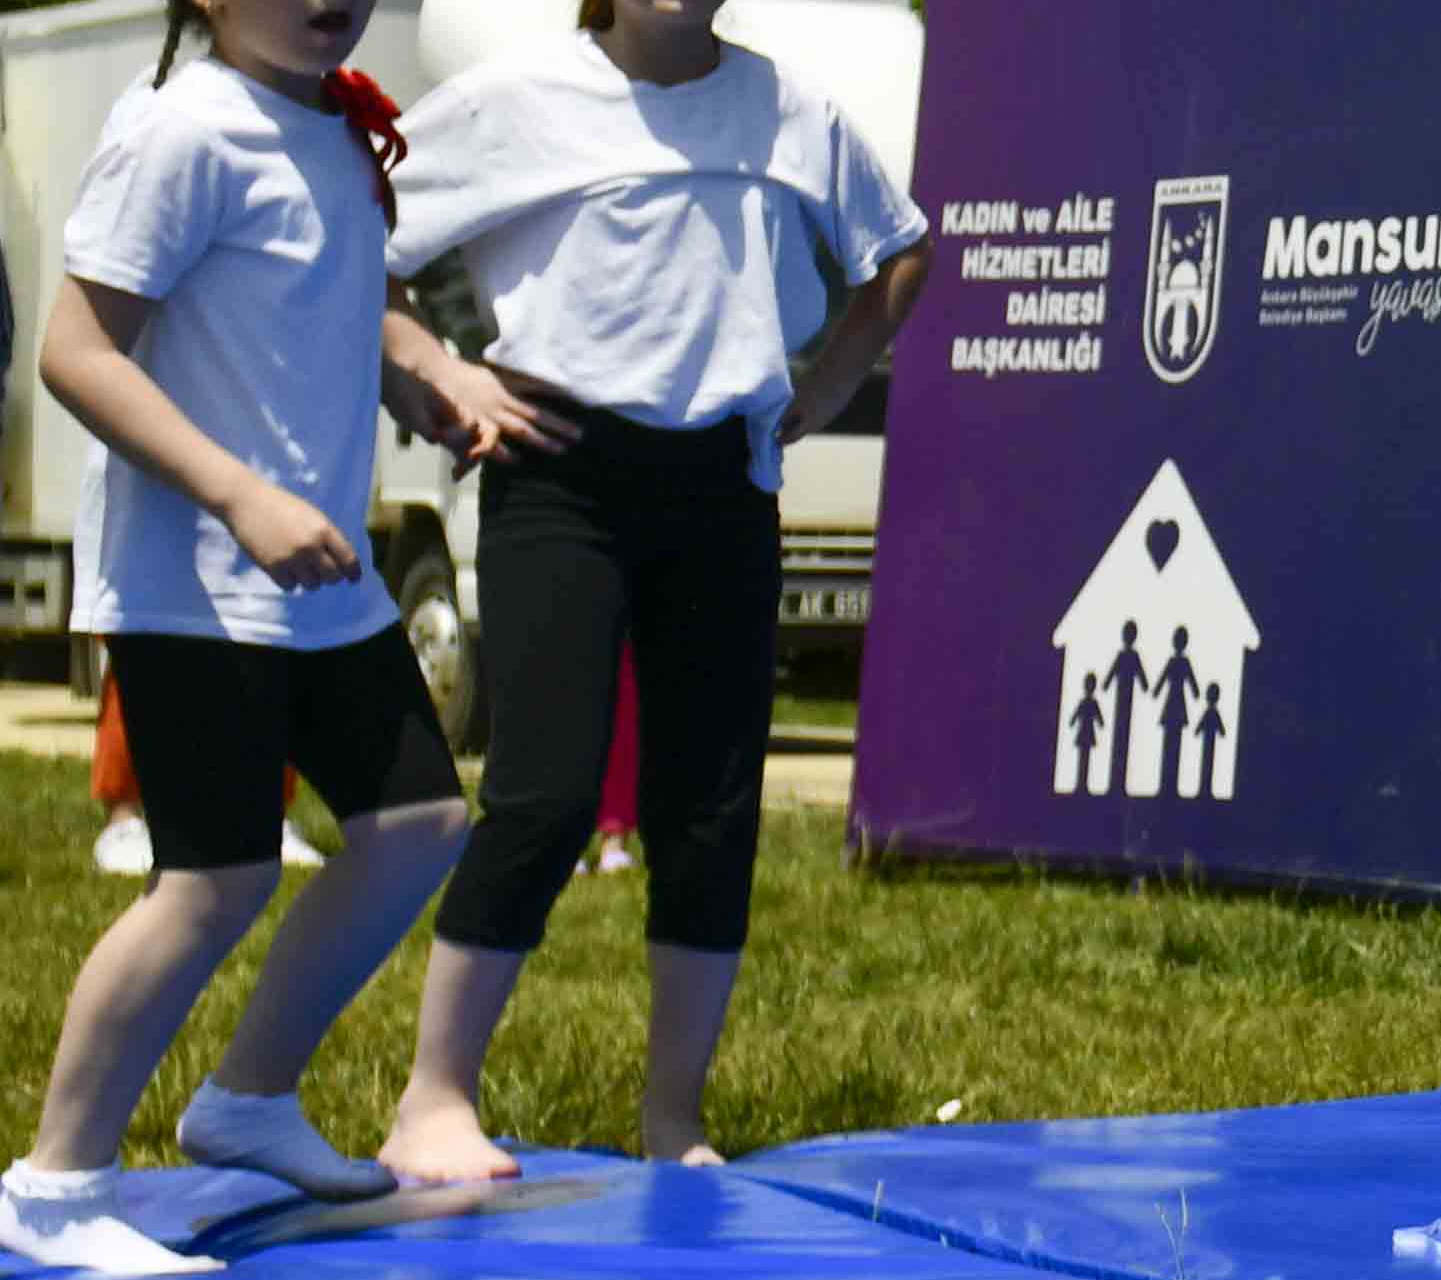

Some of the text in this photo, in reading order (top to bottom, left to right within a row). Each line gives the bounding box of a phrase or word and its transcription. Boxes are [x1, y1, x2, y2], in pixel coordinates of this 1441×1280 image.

[942, 191, 1114, 235] KADIN ve AİLE
[961, 237, 1110, 280] HİZMETLERİ
[1006, 284, 1106, 326] DAİRESİ
[952, 331, 1102, 379] BAŞKANLIĞI
